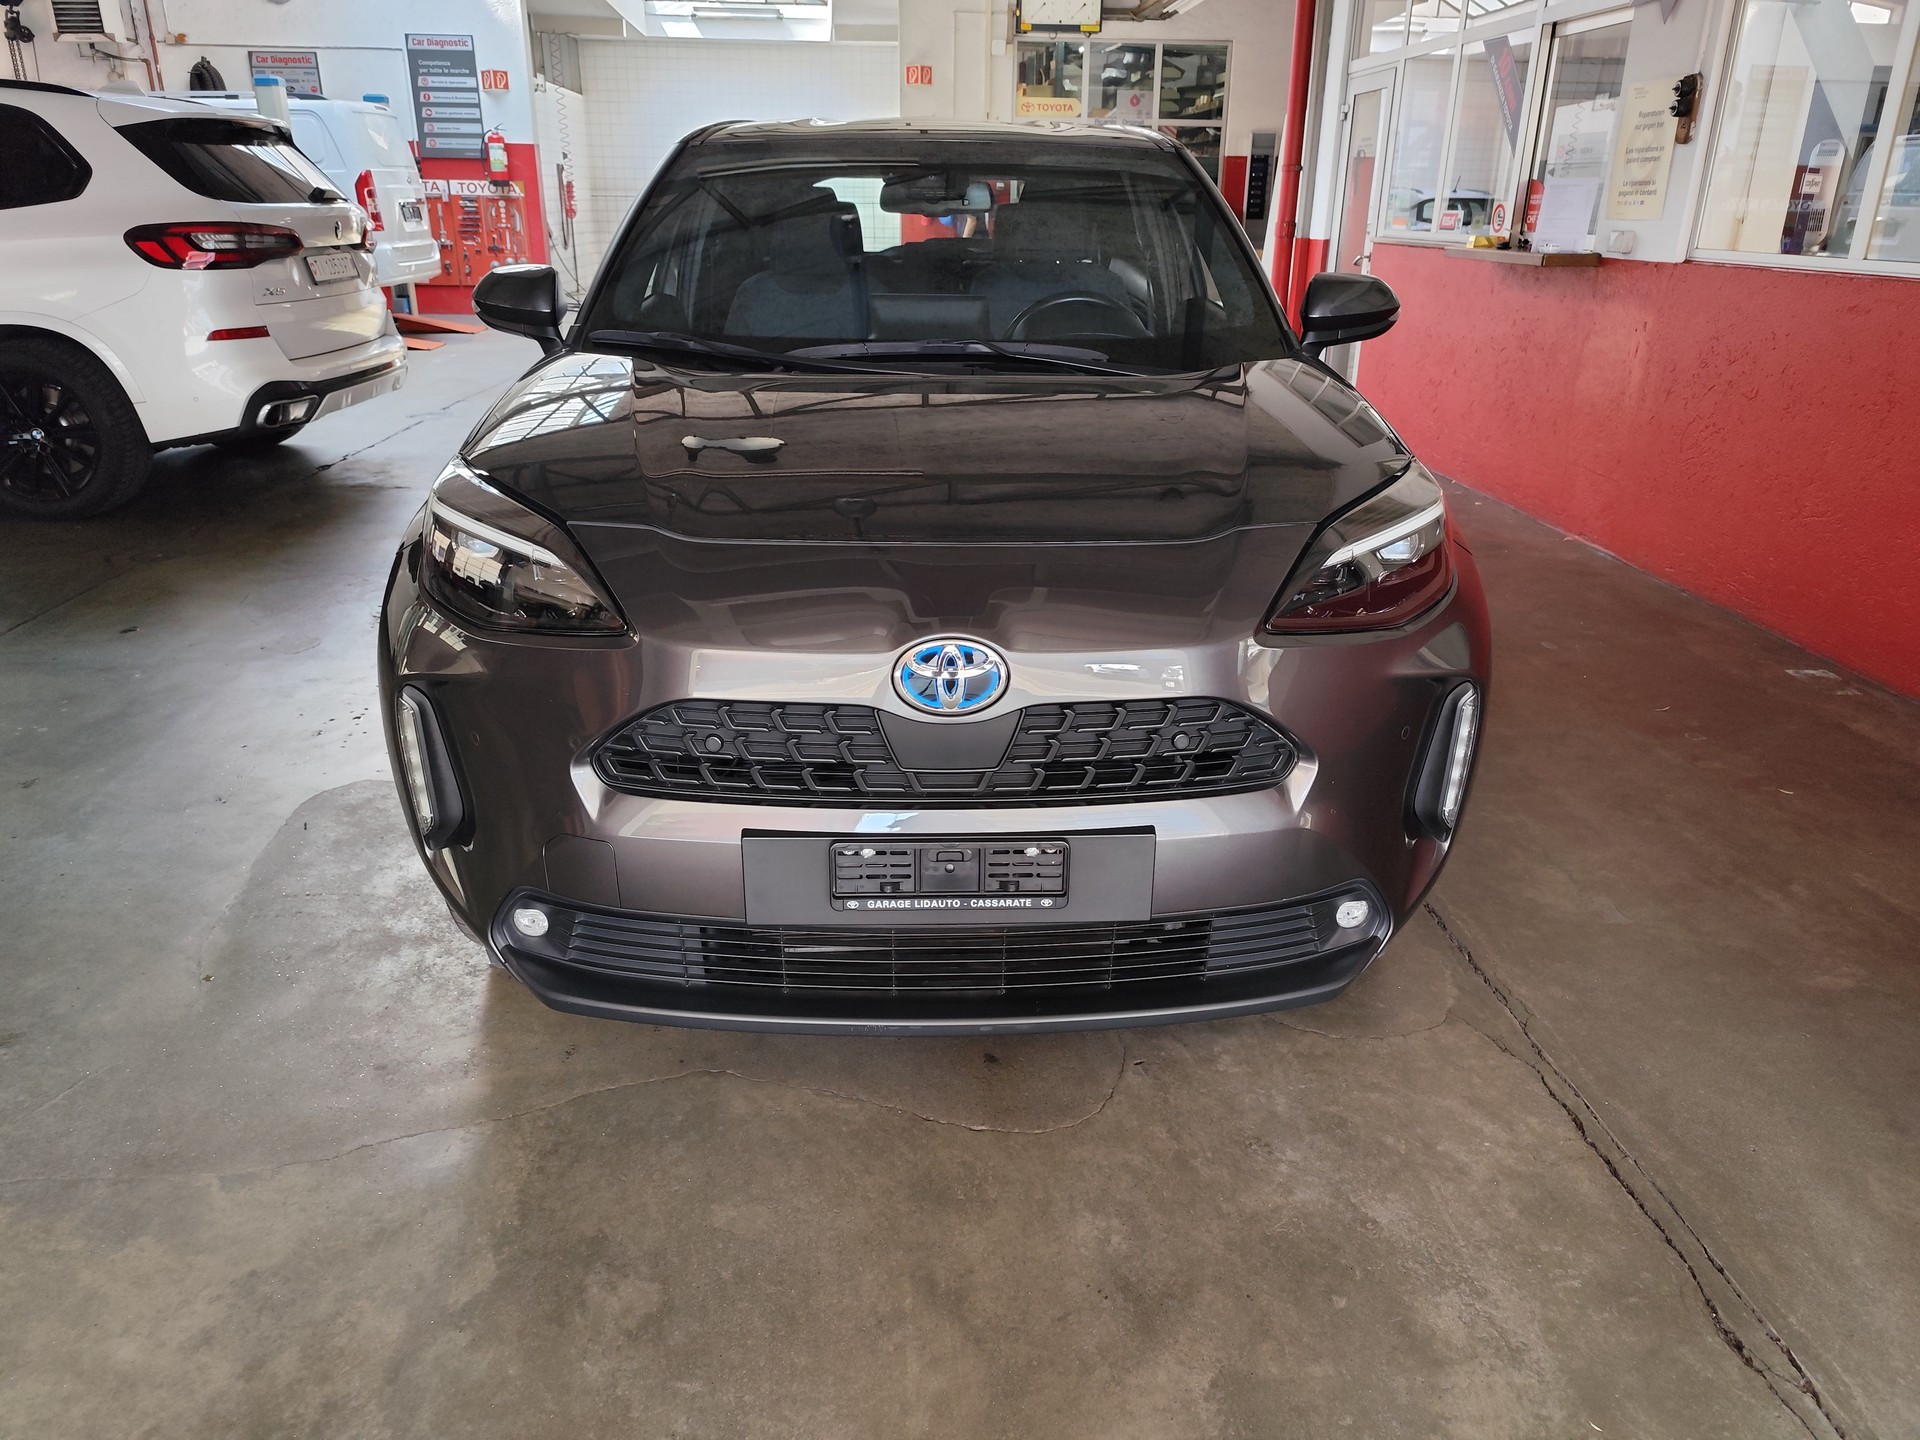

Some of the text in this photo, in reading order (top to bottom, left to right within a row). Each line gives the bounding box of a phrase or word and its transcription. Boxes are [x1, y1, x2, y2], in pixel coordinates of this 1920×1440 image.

[412, 38, 469, 48] Car Diagnostic
[270, 55, 312, 65] Diagnostic
[1037, 104, 1073, 112] TOYOTA
[1503, 103, 1513, 133] TOYOTA
[1639, 110, 1665, 118] Reparaturen
[1643, 123, 1656, 131] gegen
[1640, 155, 1661, 163] comptant
[263, 288, 286, 296] X5
[867, 900, 911, 908] GARAGE
[970, 899, 1032, 907] CASSARATE
